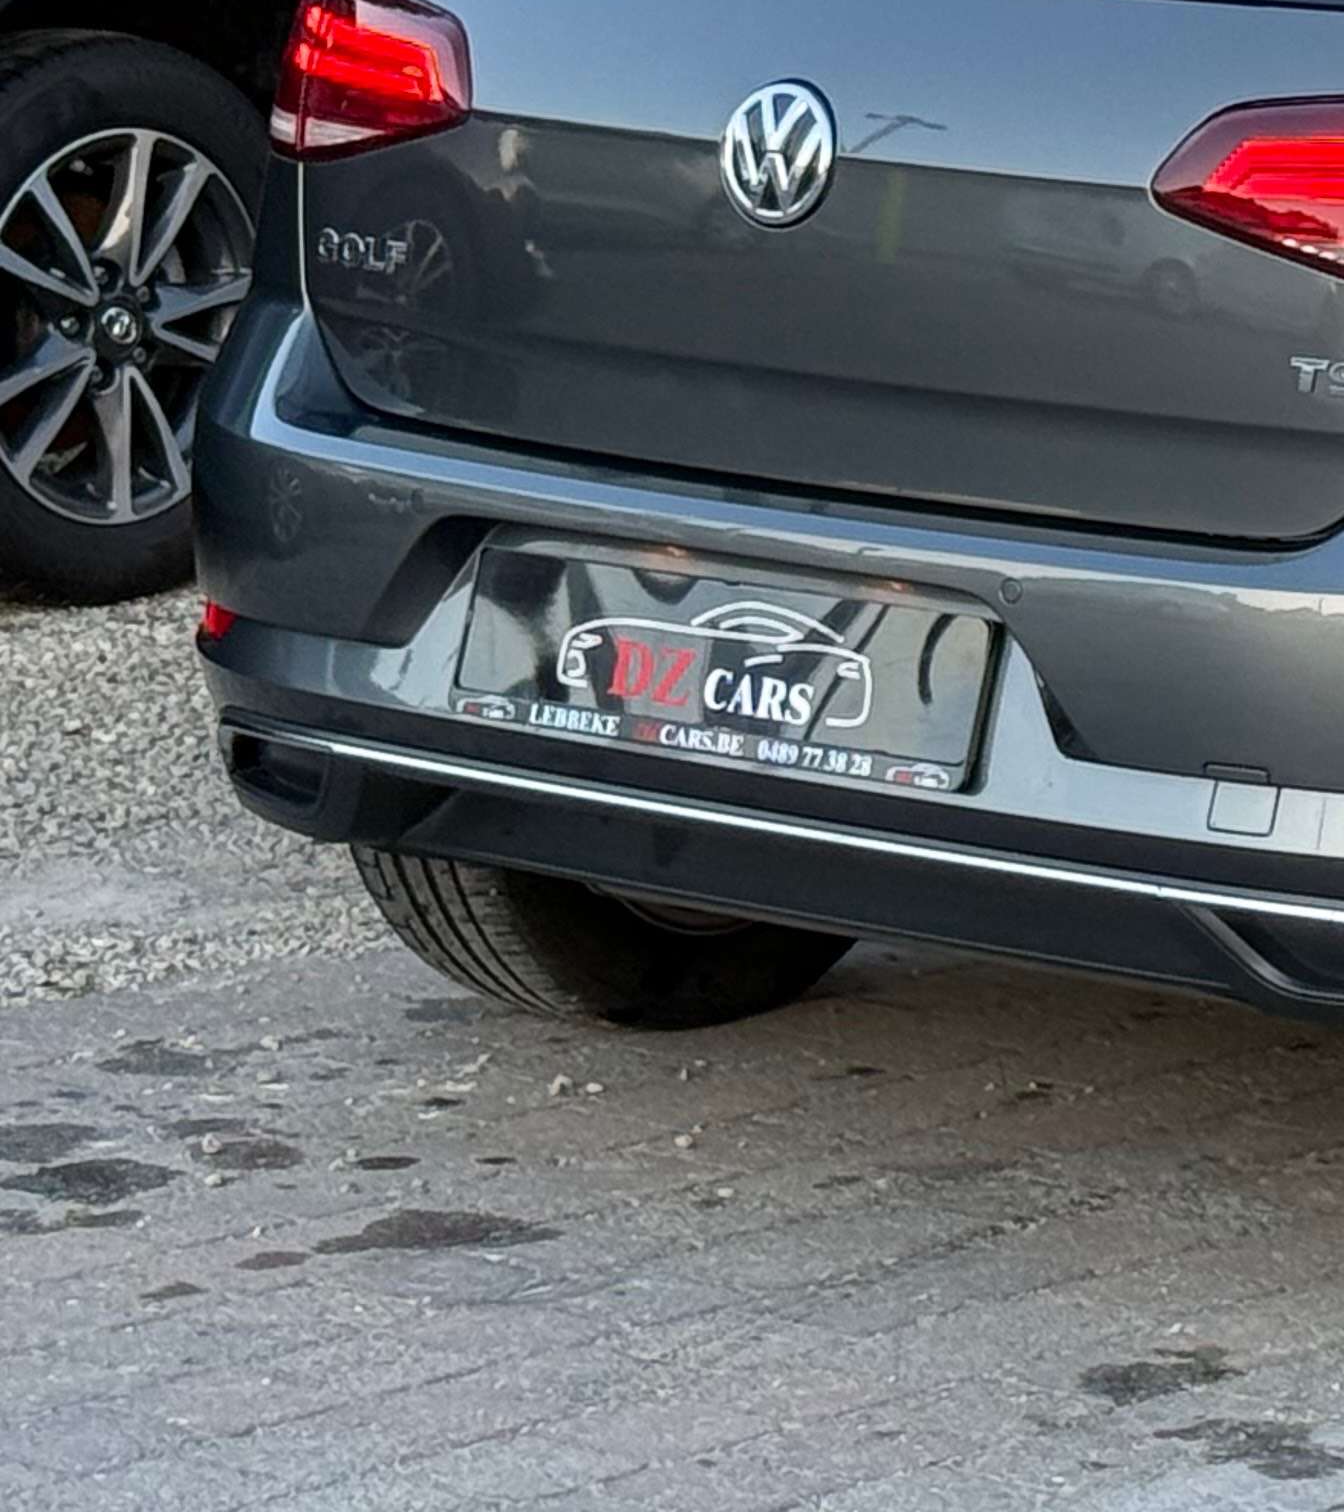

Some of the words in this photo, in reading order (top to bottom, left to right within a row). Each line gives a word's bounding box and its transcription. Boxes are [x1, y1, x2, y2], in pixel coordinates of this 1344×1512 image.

[318, 227, 407, 274] GOLF
[607, 635, 696, 707] DZ
[704, 668, 815, 725] CARS
